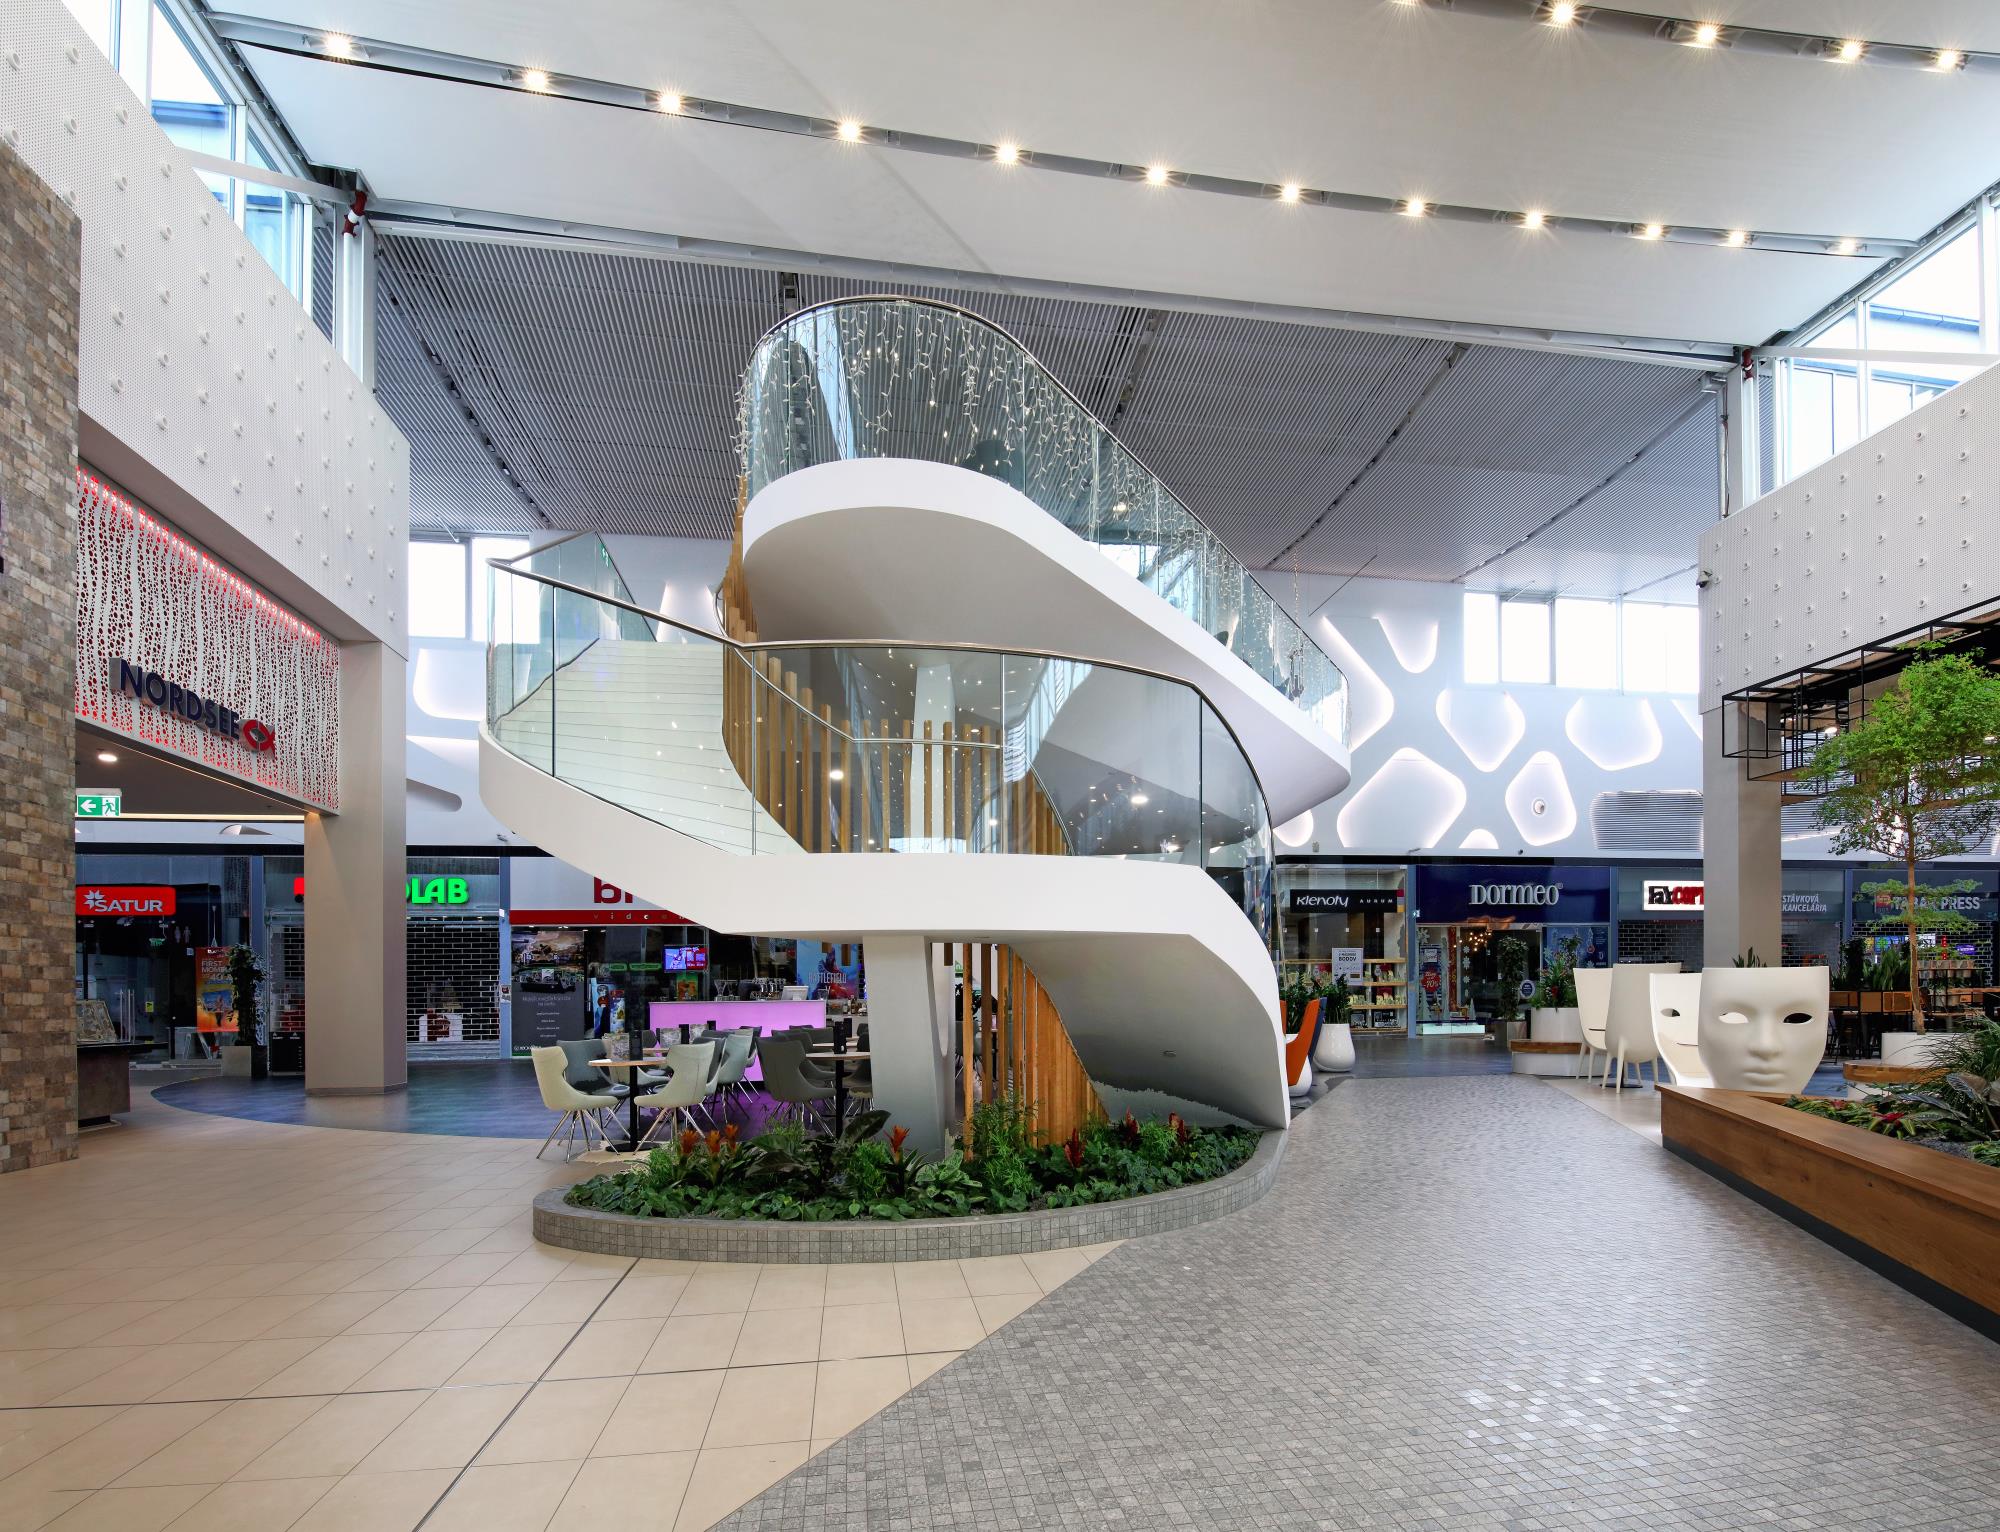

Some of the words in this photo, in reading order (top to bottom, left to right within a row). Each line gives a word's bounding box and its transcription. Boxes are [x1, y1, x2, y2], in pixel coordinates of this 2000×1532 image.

[110, 658, 239, 740] NORDSEE
[406, 877, 469, 905] LAB
[1782, 893, 1819, 903] STÁVKOVÁ
[1941, 896, 1980, 910] PRESS
[94, 899, 163, 912] SATUR
[1782, 903, 1827, 912] KANCELÁRIA
[808, 972, 847, 984] BATTLEFIELD
